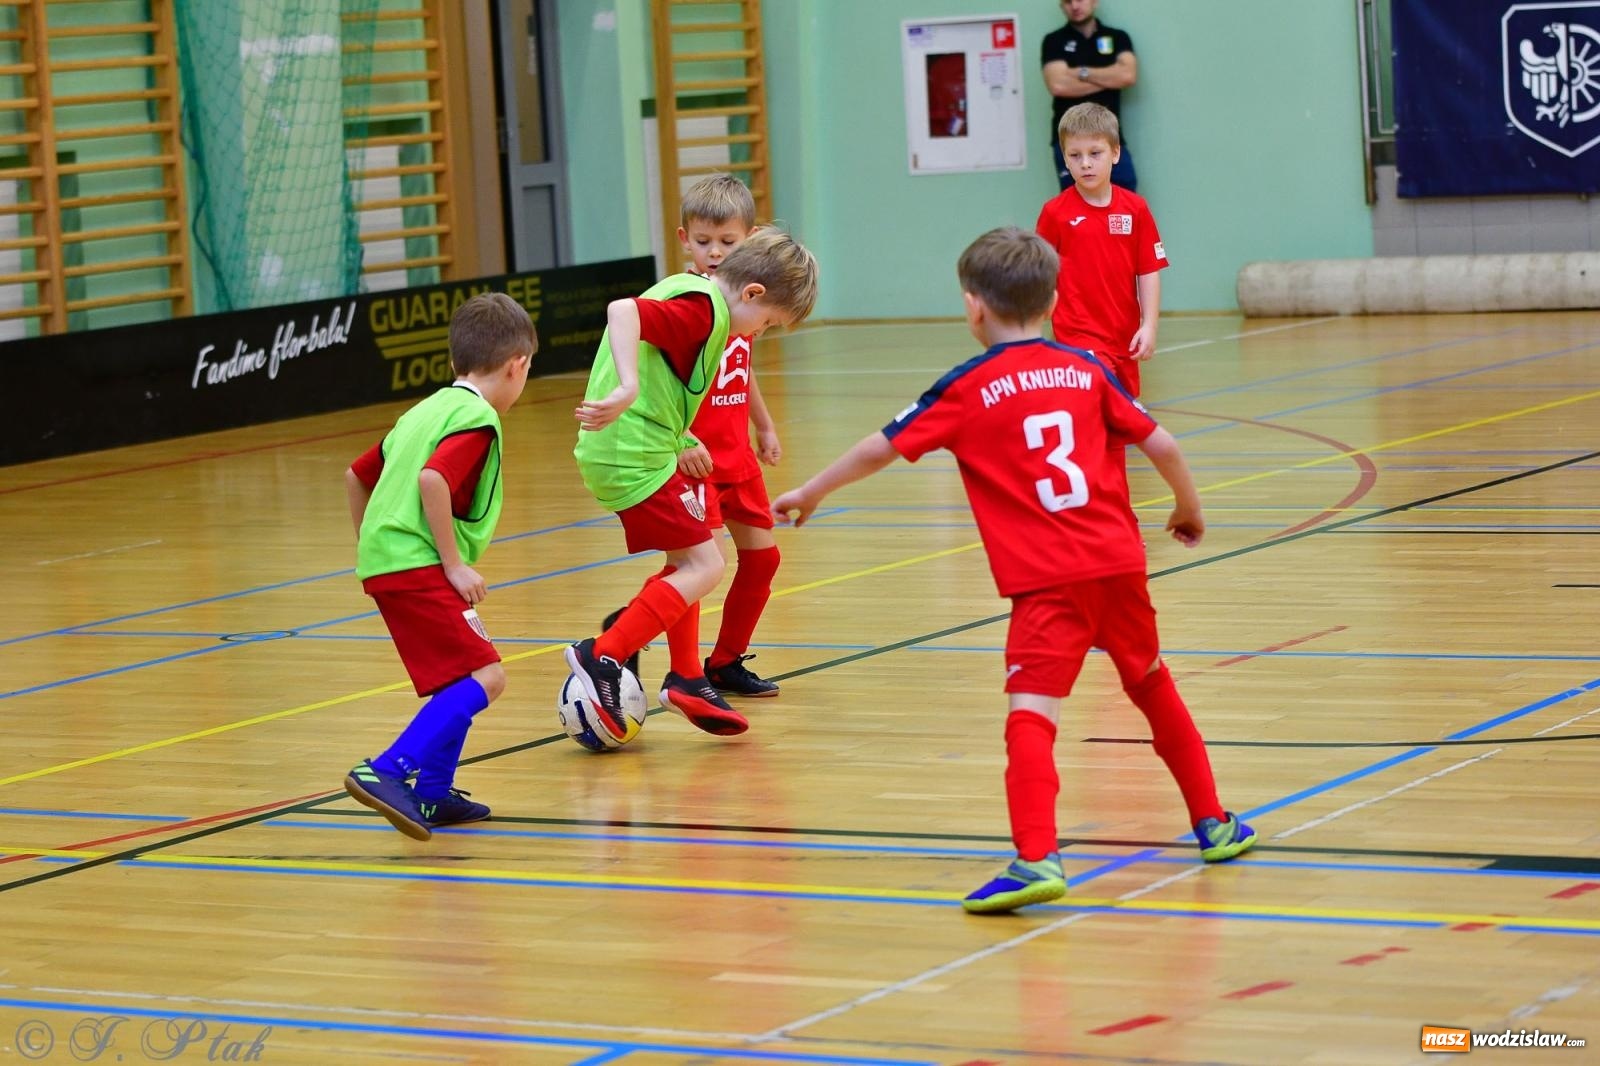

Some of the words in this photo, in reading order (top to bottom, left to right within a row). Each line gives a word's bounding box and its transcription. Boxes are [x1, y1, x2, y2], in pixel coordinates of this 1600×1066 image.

[369, 276, 543, 333] GUARAEE
[979, 374, 1017, 408] APN
[1017, 365, 1093, 391] KNURÓW
[1022, 410, 1089, 513] 3
